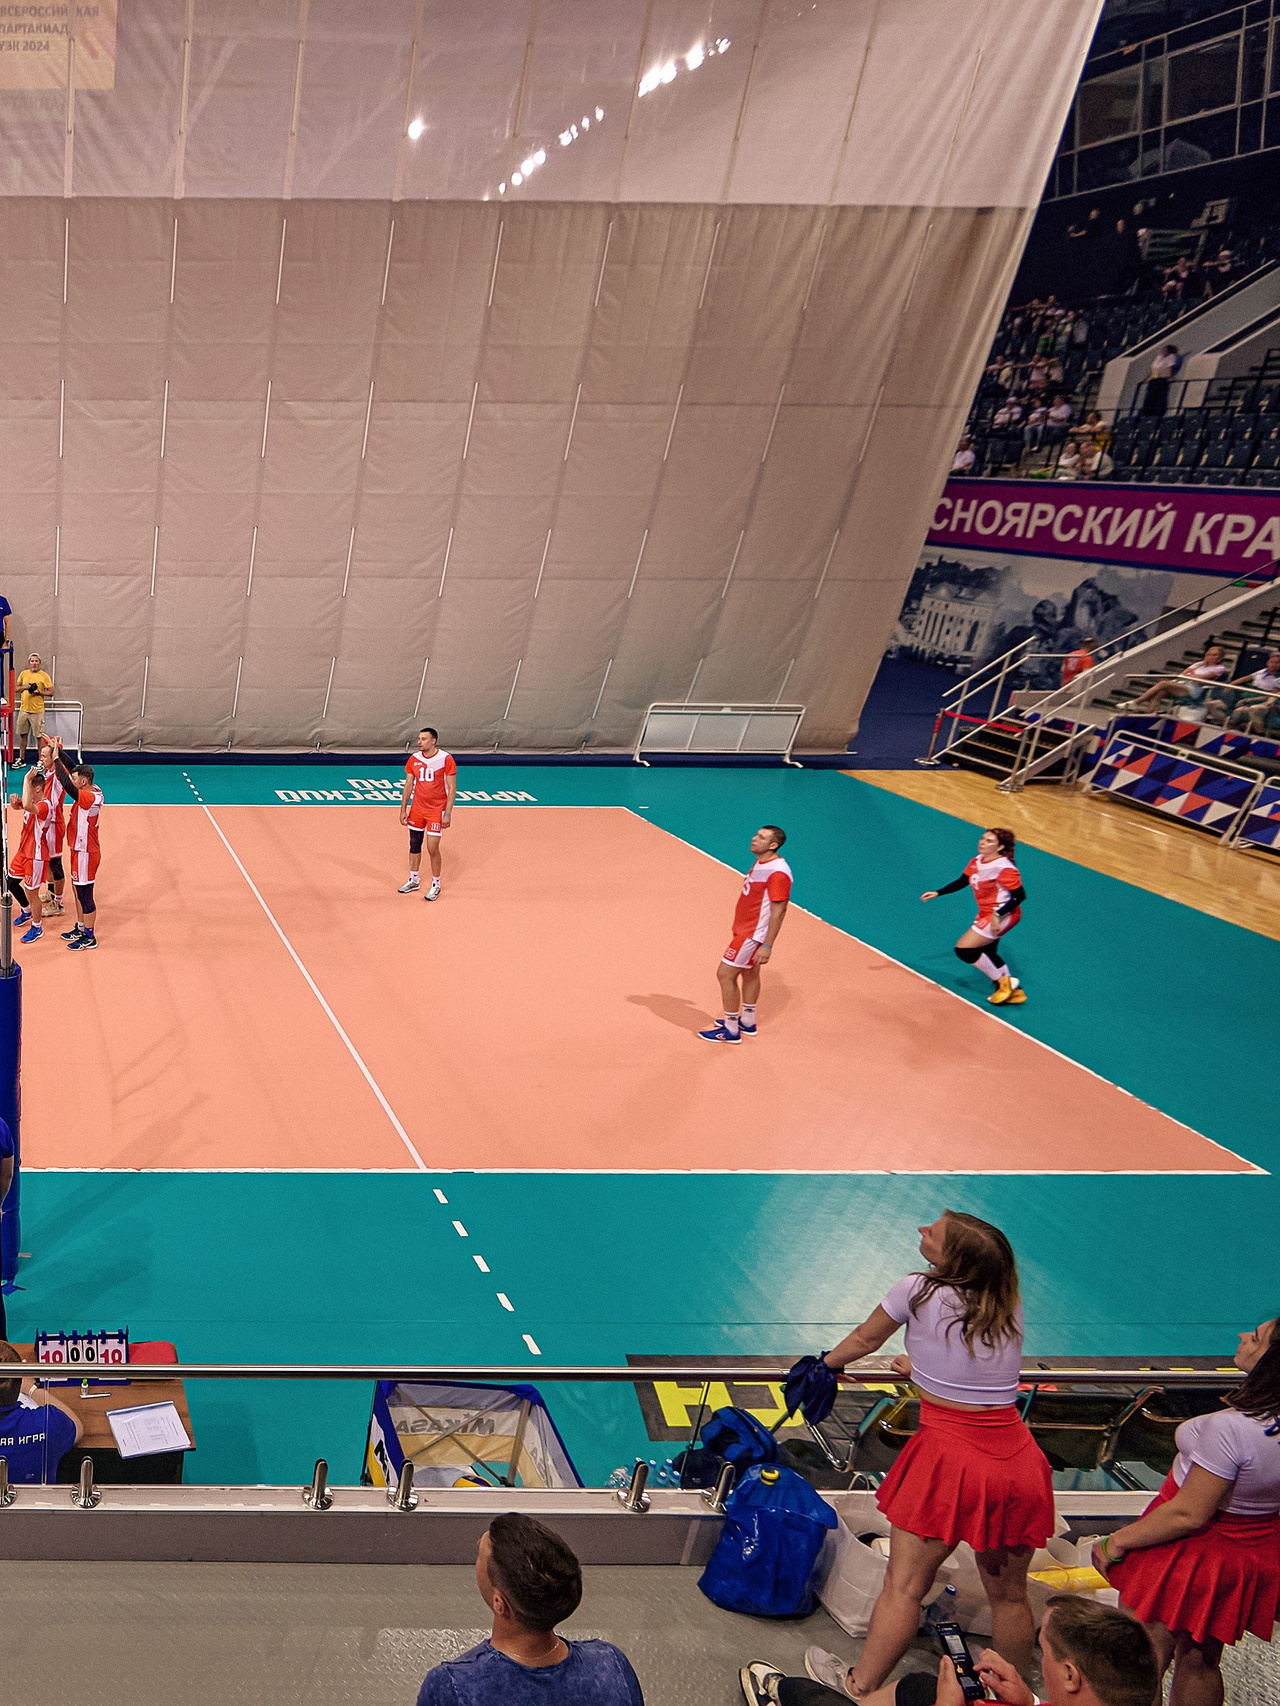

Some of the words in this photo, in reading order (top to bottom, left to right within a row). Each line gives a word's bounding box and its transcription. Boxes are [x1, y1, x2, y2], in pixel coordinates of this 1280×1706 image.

[0, 5, 99, 17] ВСЕРОССИЙКАЯ
[22, 40, 50, 52] 2024
[418, 766, 434, 782] 10
[346, 778, 410, 791] РАЙ
[274, 790, 538, 803] КРАСЯРСКИЙ
[19, 1433, 46, 1445] ИГРА
